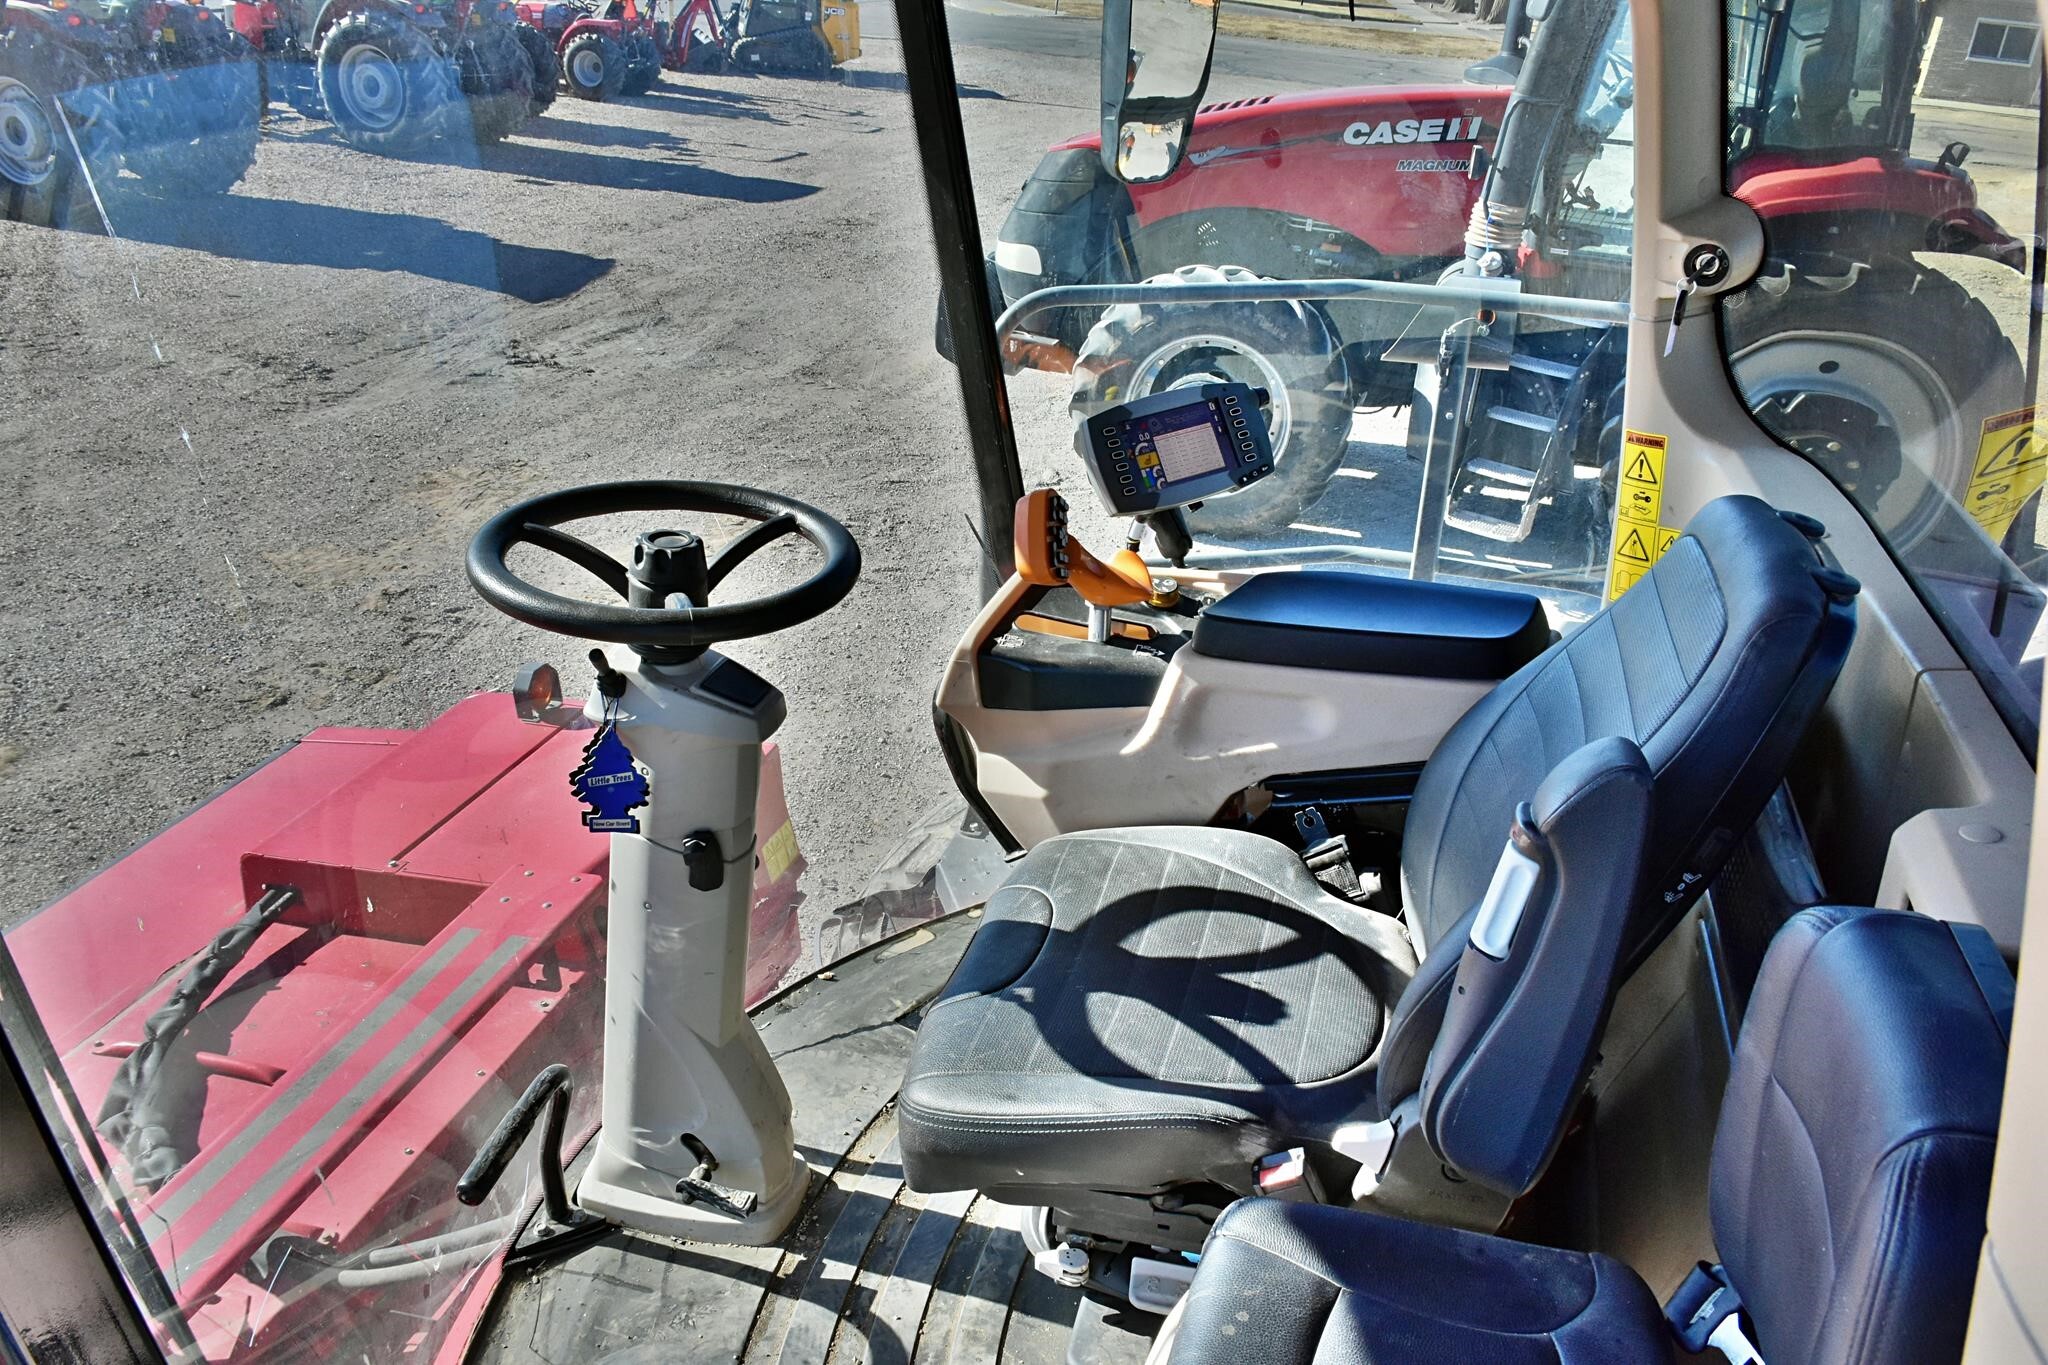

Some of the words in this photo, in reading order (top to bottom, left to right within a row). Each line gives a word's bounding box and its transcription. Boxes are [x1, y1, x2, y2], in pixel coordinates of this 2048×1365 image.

[824, 8, 845, 16] JCB
[1343, 118, 1446, 145] CASE
[1396, 159, 1471, 172] MAGNUM
[1634, 435, 1664, 448] WARNING
[590, 776, 610, 786] Little
[612, 774, 631, 783] Trees
